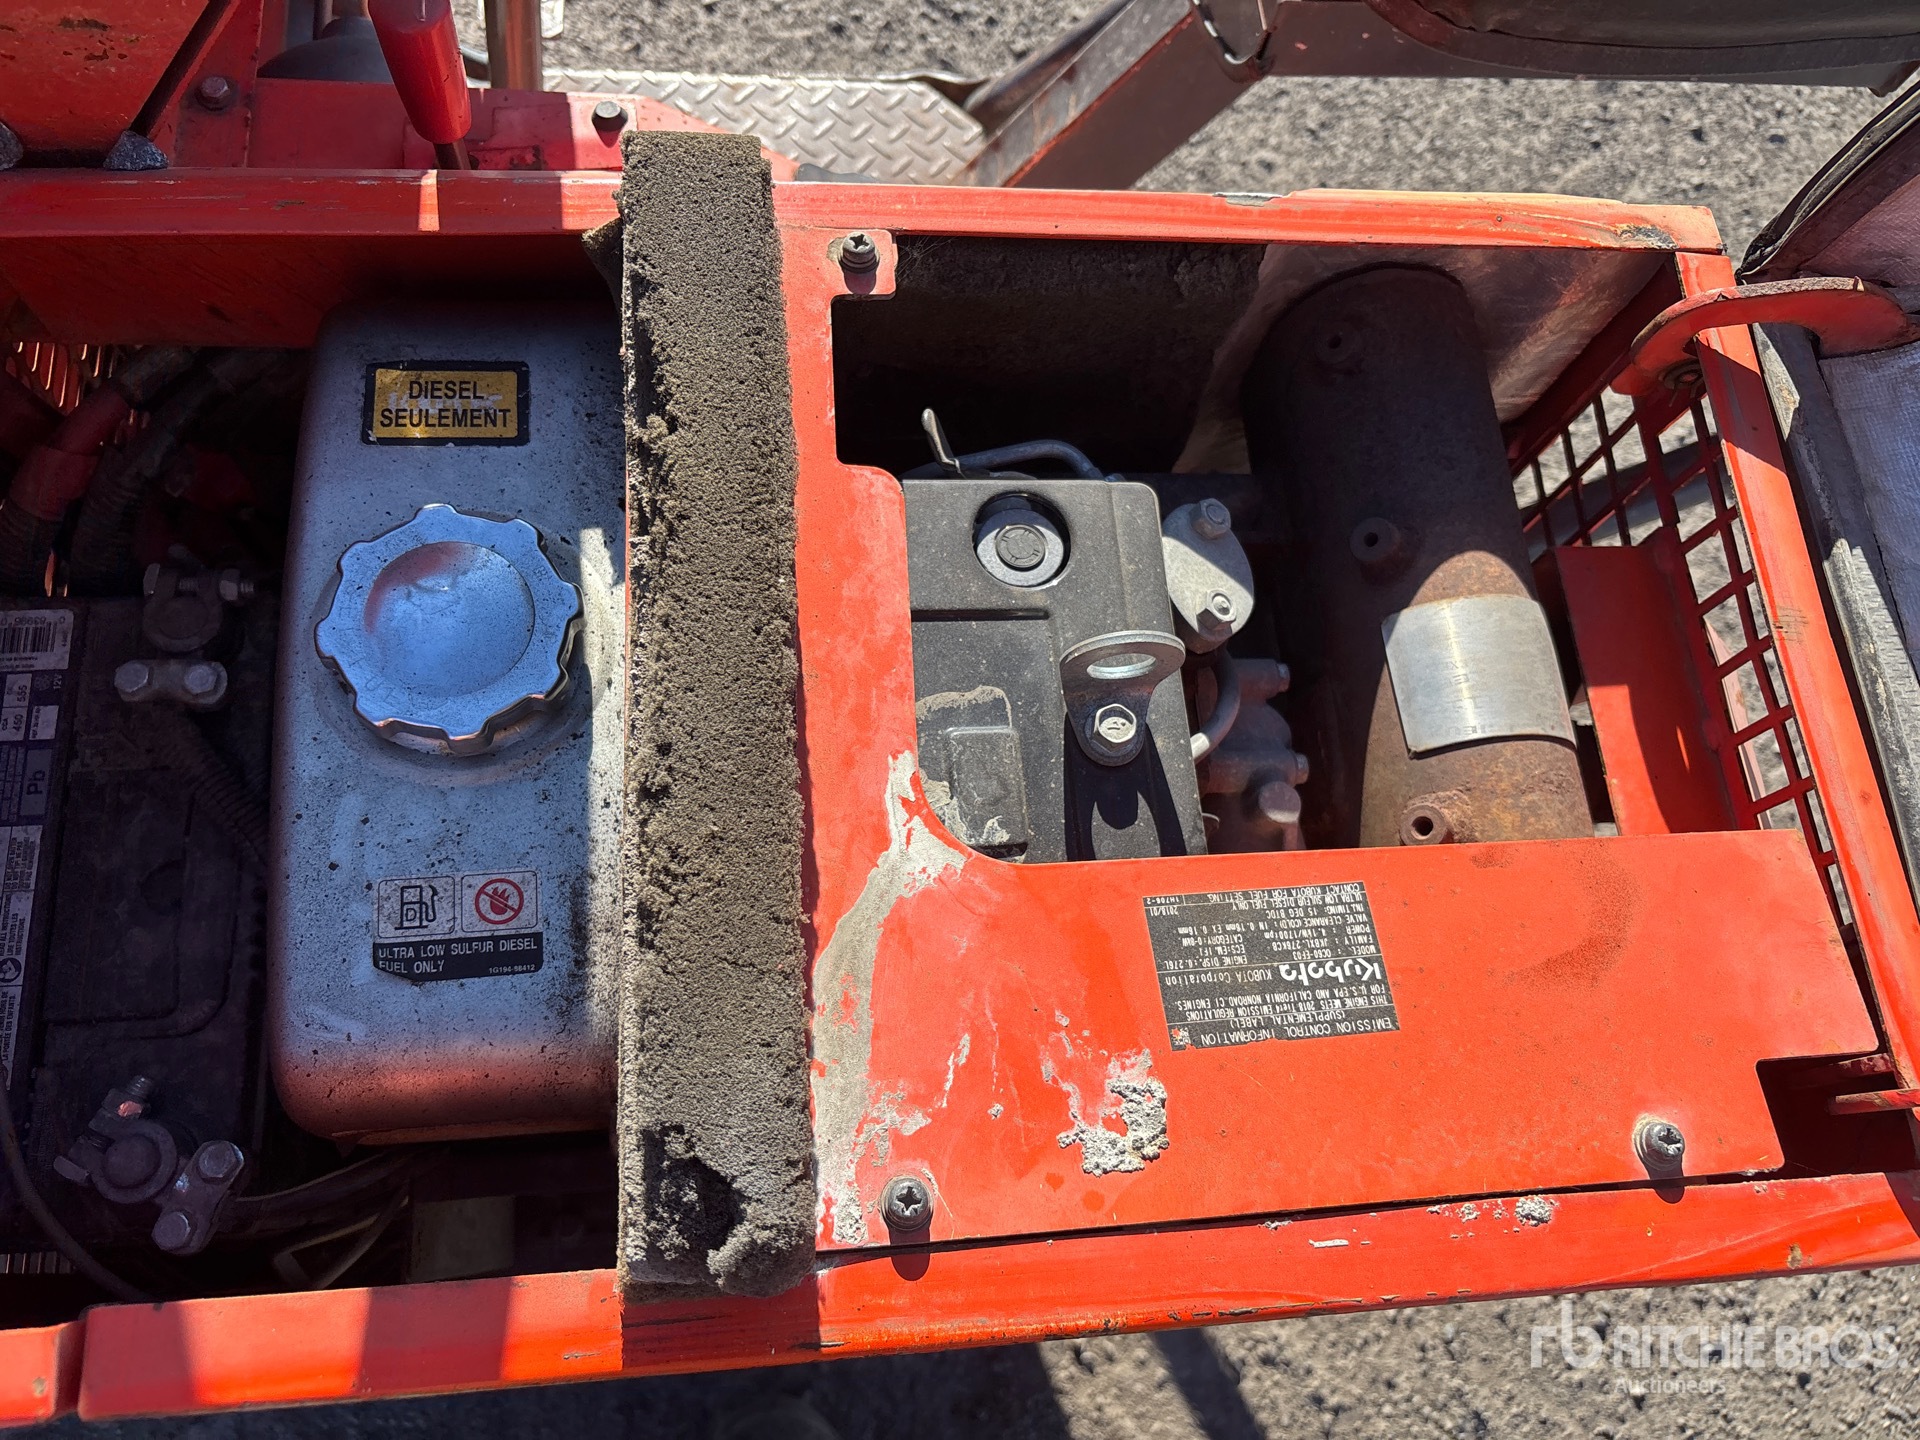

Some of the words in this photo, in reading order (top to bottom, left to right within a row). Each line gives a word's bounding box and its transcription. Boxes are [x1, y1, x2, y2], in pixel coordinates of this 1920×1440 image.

[409, 380, 485, 400] DIESEL
[380, 408, 511, 428] SEULEMENT
[53, 674, 63, 690] 12V
[16, 684, 27, 703] 555
[13, 713, 23, 732] 450
[26, 769, 46, 796] Pb
[1271, 888, 1287, 897] FOR
[1290, 886, 1321, 896] KUBOTA
[1324, 883, 1360, 894] CONTACT
[1248, 890, 1268, 899] FUEL
[1323, 894, 1338, 904] LOW
[1339, 891, 1362, 902] ULTRA
[1231, 900, 1249, 910] ONLY
[1249, 899, 1267, 909] FUEL
[1270, 897, 1295, 908] DIESEL
[1296, 895, 1322, 906] SULFUR
[1148, 905, 1178, 916] 2018/01
[1265, 908, 1285, 918] BTDC
[1287, 907, 1304, 916] DEG
[1307, 906, 1317, 915] 15
[1344, 913, 1367, 923] VALVE
[1211, 924, 1222, 933] EX
[1344, 923, 1370, 934] POWER
[1342, 934, 1373, 944] FAMILY
[378, 947, 415, 960] ULTRA
[421, 944, 446, 957] LOW
[451, 940, 494, 956] SULFUR
[500, 937, 538, 952] DIESEL
[1350, 944, 1376, 955] MODEL
[1221, 954, 1247, 965] ENGINE
[378, 960, 408, 974] FUEL
[413, 960, 444, 974] ONLY
[1278, 956, 1381, 987] Kubota
[1164, 970, 1231, 988] Corporation
[1234, 968, 1272, 982] KUBOTA
[1314, 988, 1330, 998] AND
[1369, 983, 1385, 994] FOR
[1227, 994, 1261, 1006] NONROAD
[1264, 989, 1312, 1003] CALIFORNIA
[1342, 996, 1368, 1007] ENGINE
[1369, 994, 1387, 1004] THIS
[1174, 998, 1210, 1010] ENGINES.
[1274, 1002, 1295, 1013] Tier4
[1297, 1000, 1315, 1011] 2018
[1319, 998, 1341, 1009] MEETS
[1185, 1007, 1234, 1021] REGULATIONS
[1236, 1004, 1273, 1016] EMISSION
[1229, 1016, 1263, 1028] LABEL)
[1270, 1009, 1345, 1025] (SUPPLEMENTAL
[1283, 1022, 1331, 1037] CONTROL
[1335, 1017, 1391, 1032] EMISSION
[1200, 1027, 1275, 1045] INFORMATION
[2, 1053, 8, 1061] LA
